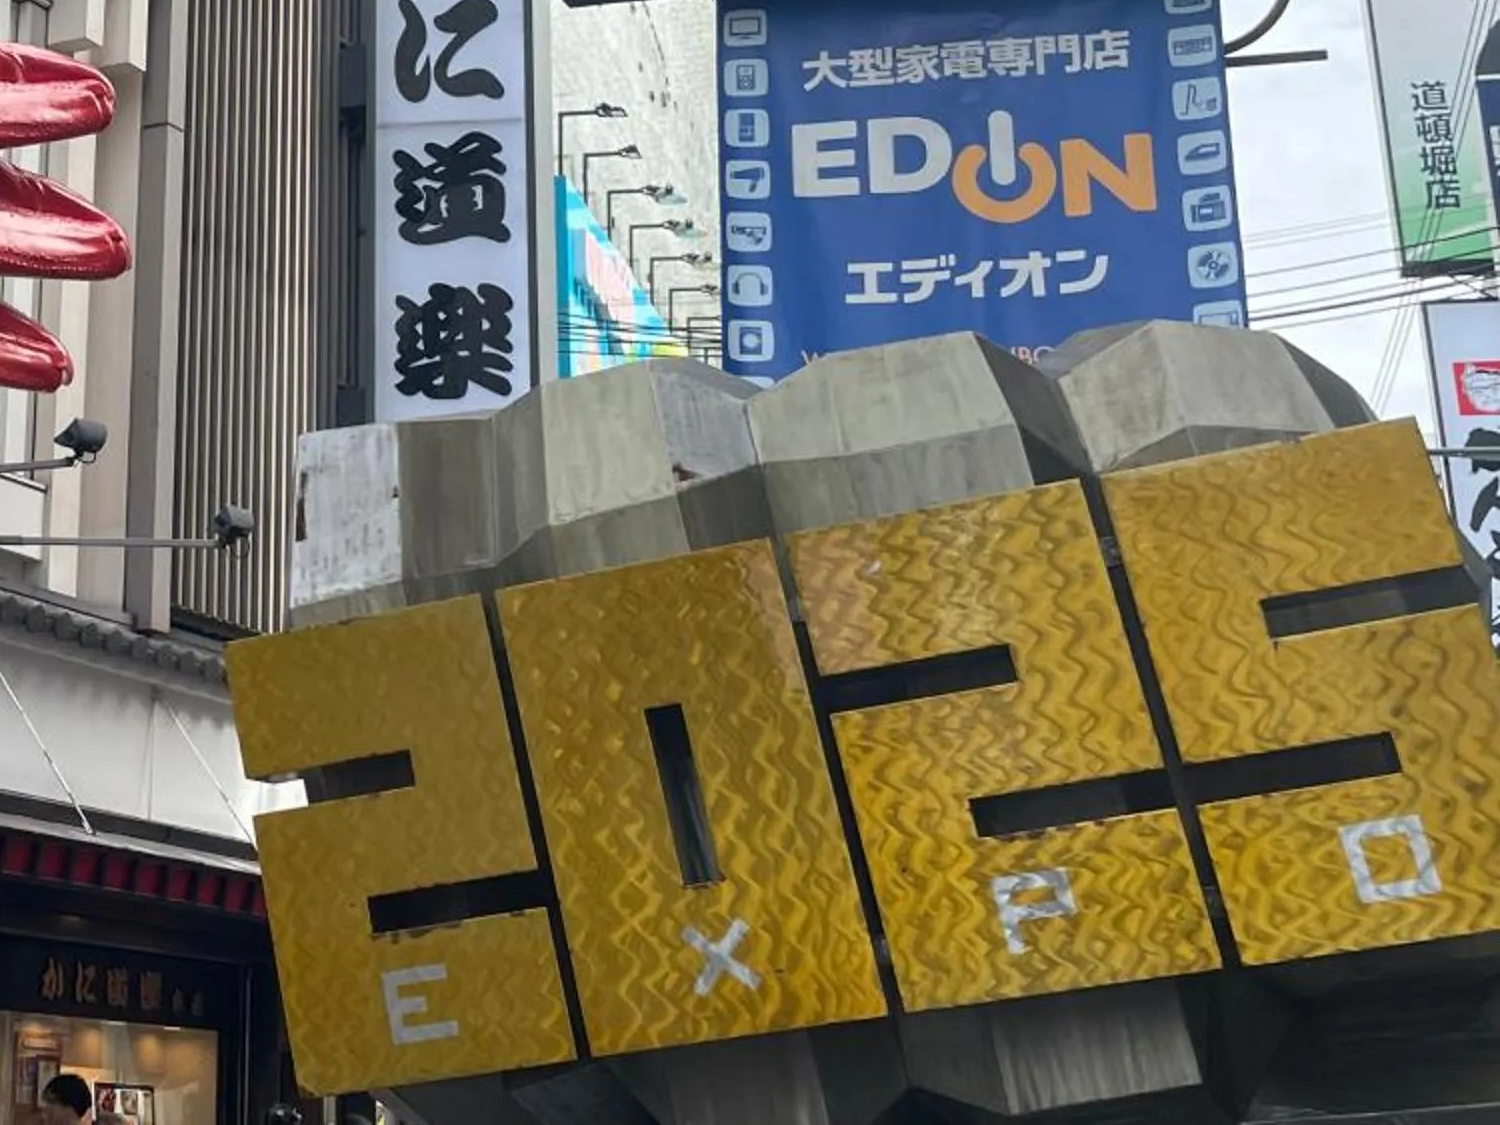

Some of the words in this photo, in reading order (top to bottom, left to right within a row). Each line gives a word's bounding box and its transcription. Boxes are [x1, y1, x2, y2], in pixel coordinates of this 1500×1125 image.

[803, 29, 1130, 92] 大型家電専門店
[792, 110, 1157, 223] EDION
[1411, 80, 1461, 208] 道頓堀店
[845, 250, 1108, 304] エディオン
[225, 418, 1500, 1096] 2025
[382, 815, 1442, 1044] EXPO
